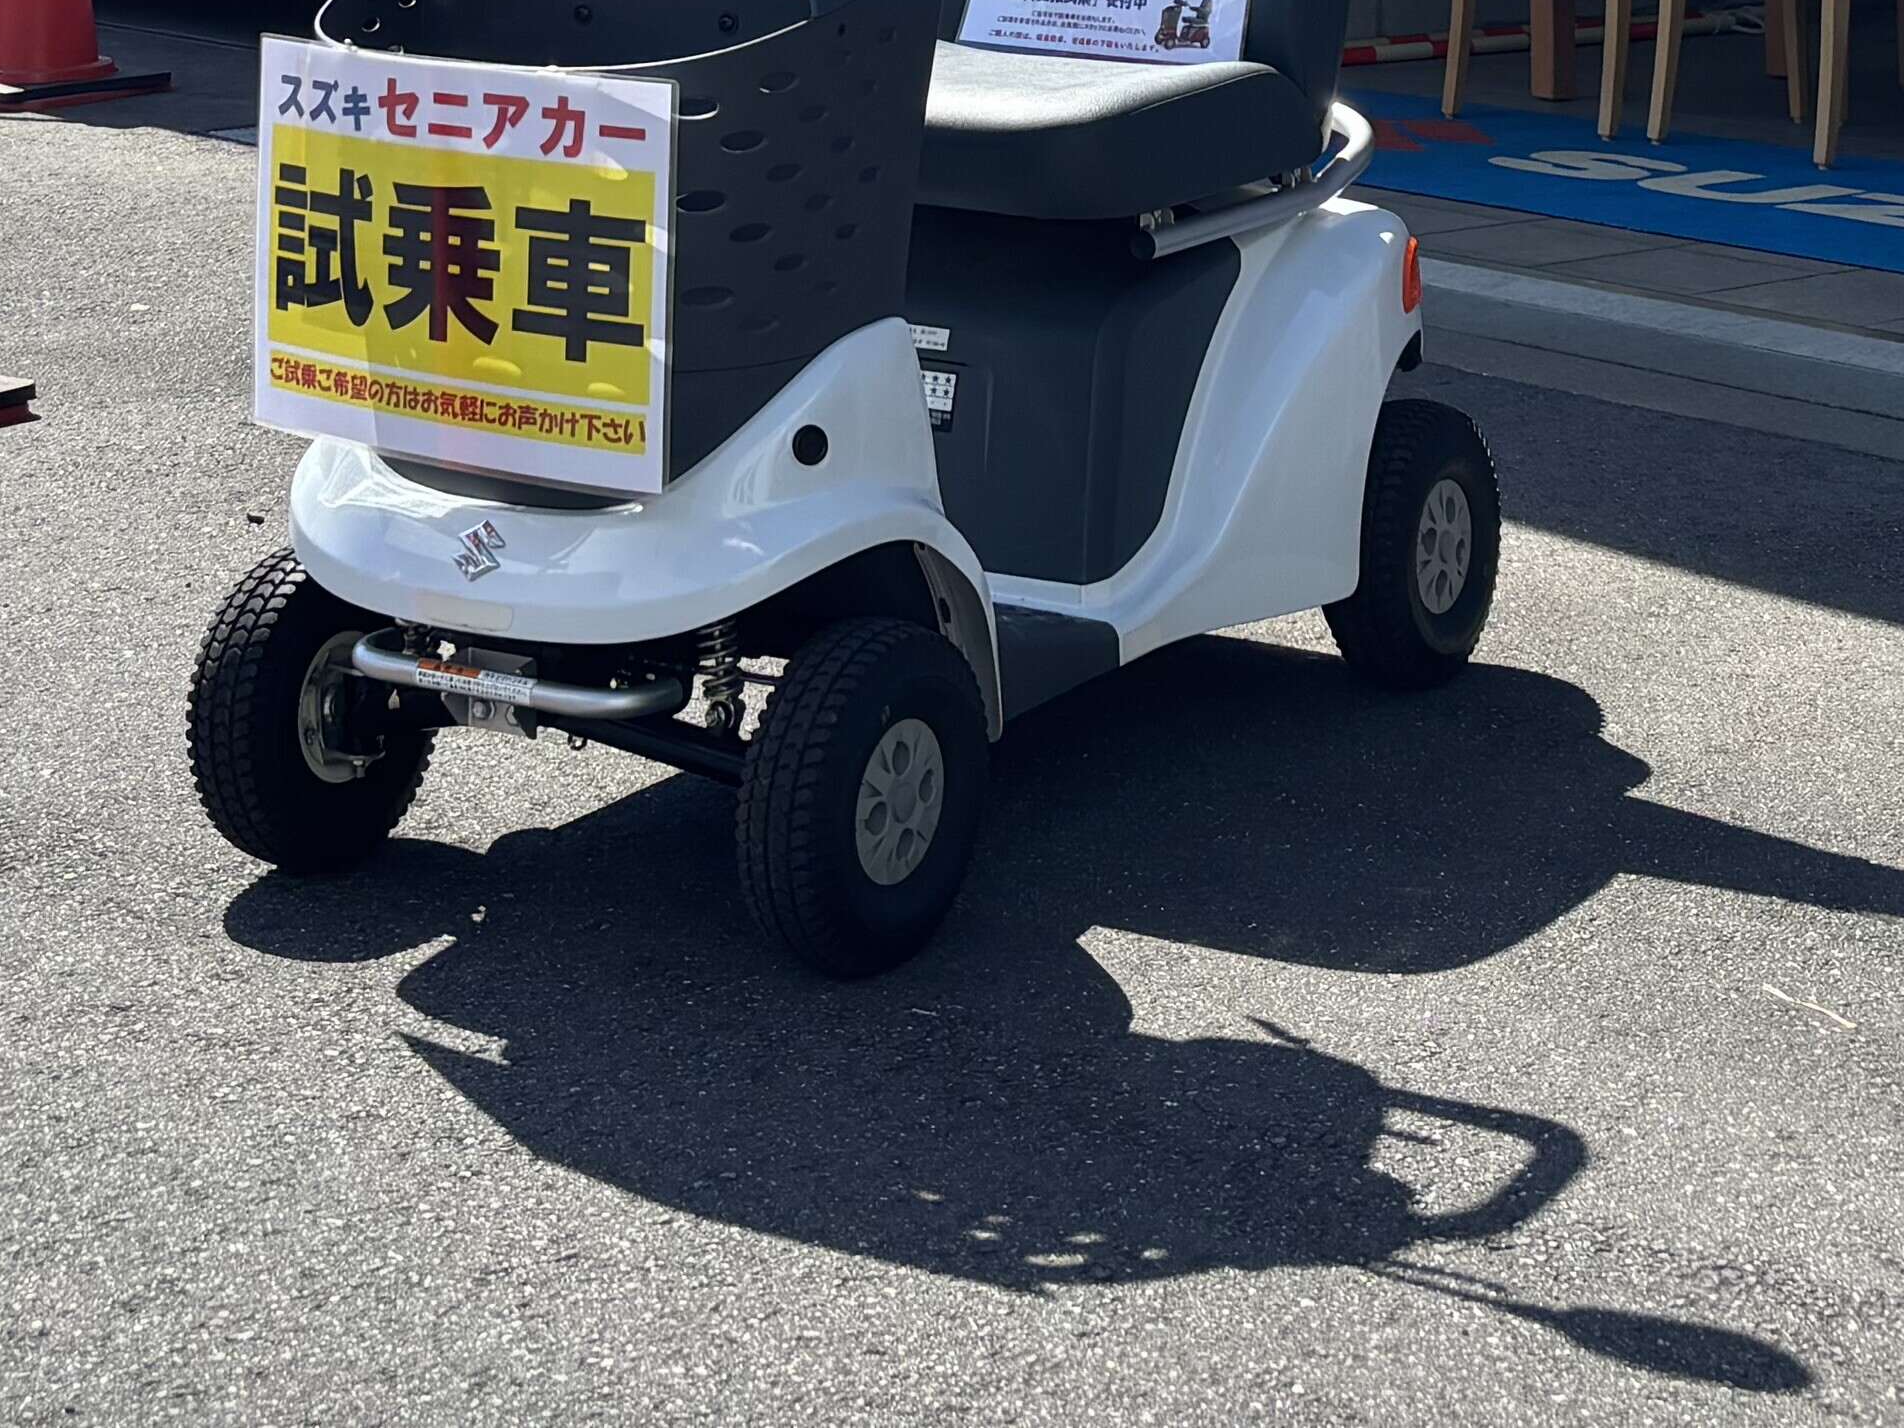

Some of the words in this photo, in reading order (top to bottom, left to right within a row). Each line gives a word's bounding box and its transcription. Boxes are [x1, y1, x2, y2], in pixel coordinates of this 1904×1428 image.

[274, 163, 650, 364] 試乗車
[270, 355, 647, 446] ご試乗ご希望の方はお気軽にお声かけ下さい
